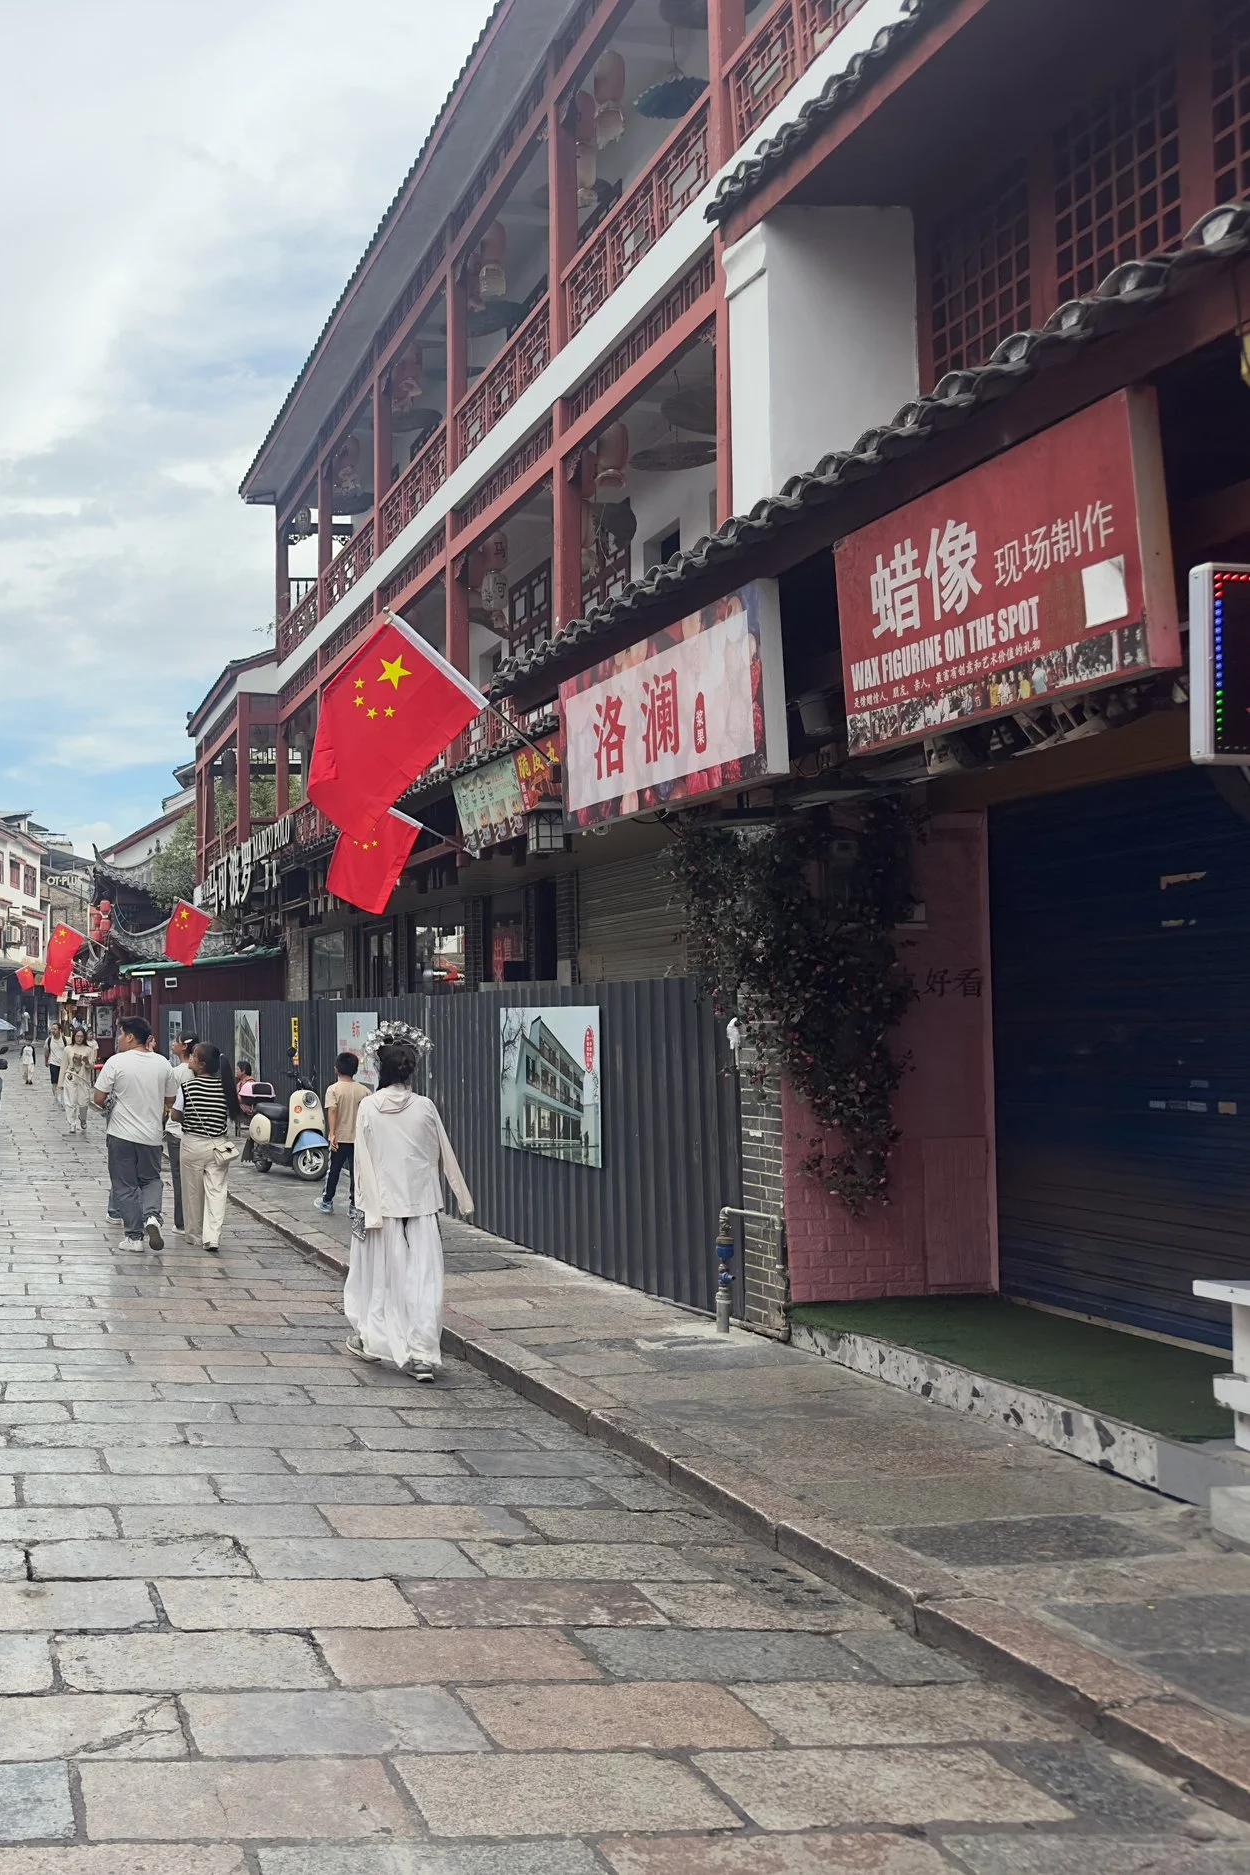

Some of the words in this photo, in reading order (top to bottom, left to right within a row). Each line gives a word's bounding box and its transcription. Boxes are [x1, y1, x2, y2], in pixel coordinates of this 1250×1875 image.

[870, 519, 982, 640] 蜡像
[993, 500, 1115, 588] 现场制作
[851, 658, 881, 692] WAX
[881, 634, 943, 683] FIGURINE
[944, 625, 966, 662] ON
[967, 613, 996, 654] THE
[997, 596, 1040, 643] SPOT
[593, 667, 681, 781] 洛澜
[695, 709, 705, 746] 浆果
[208, 841, 252, 914] 马可波罗
